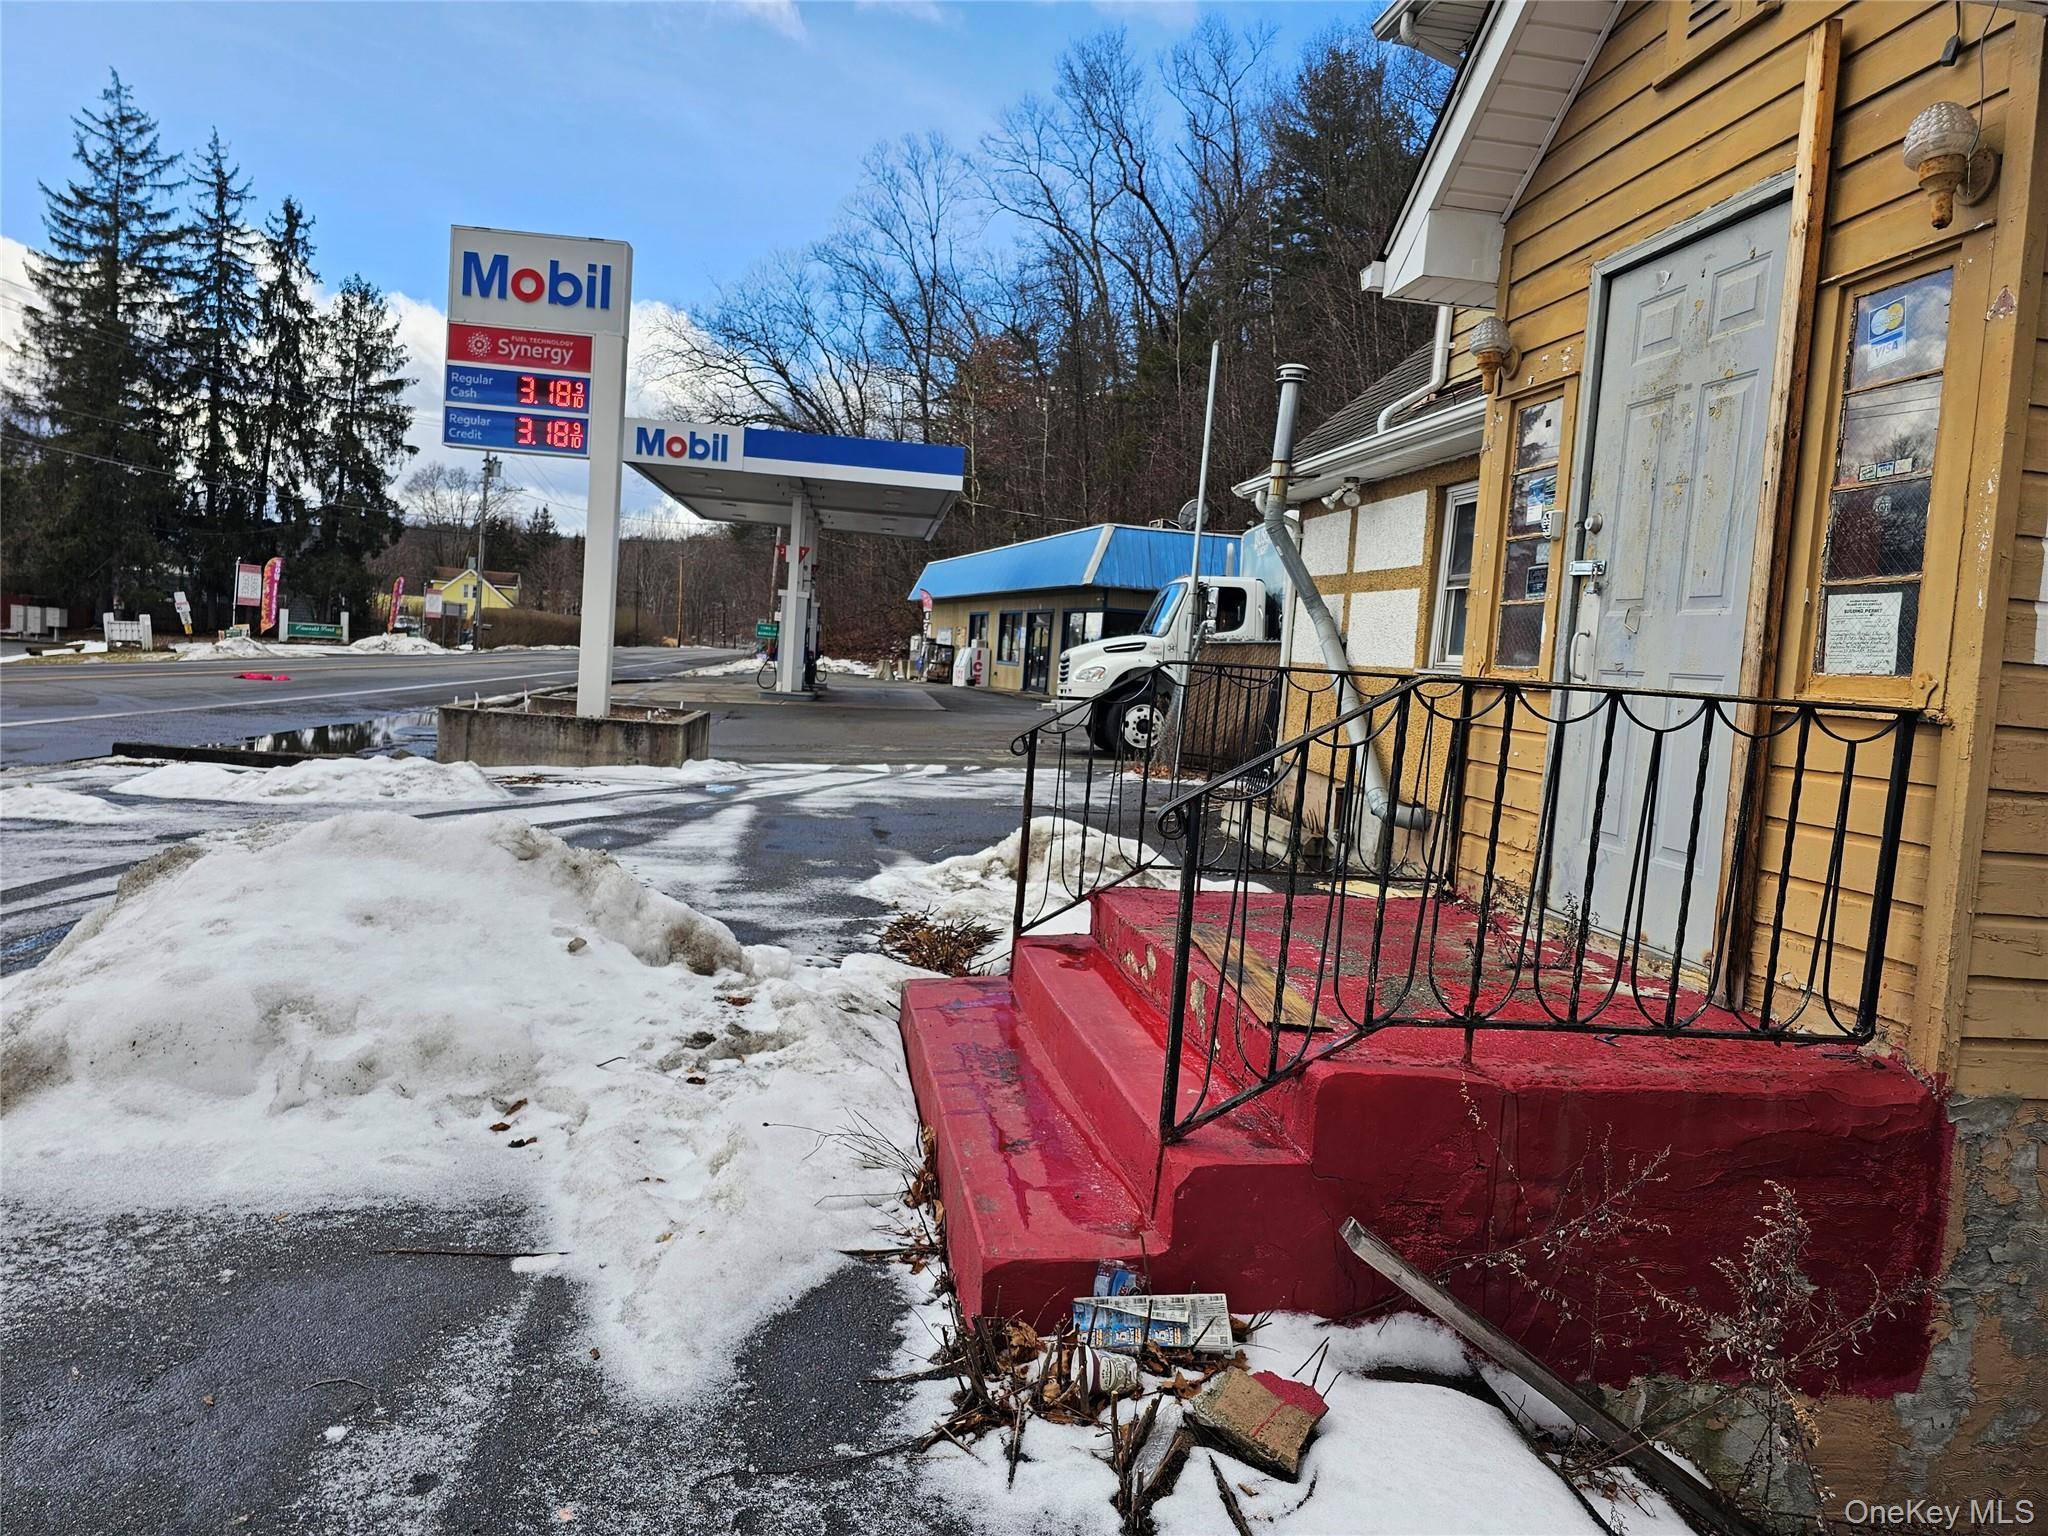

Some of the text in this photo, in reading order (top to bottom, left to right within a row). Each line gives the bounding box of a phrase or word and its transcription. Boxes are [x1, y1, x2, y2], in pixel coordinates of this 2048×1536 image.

[462, 251, 612, 310] Mobil
[511, 335, 574, 347] FUEL TECHNOLOGY
[498, 339, 573, 365] Synergy
[1874, 341, 1898, 358] VISA
[451, 372, 494, 386] Regular
[450, 387, 477, 399] Cash
[449, 413, 492, 427] Regular
[448, 428, 482, 440] Credit
[636, 427, 729, 462] Mobil
[973, 650, 983, 684] ICE
